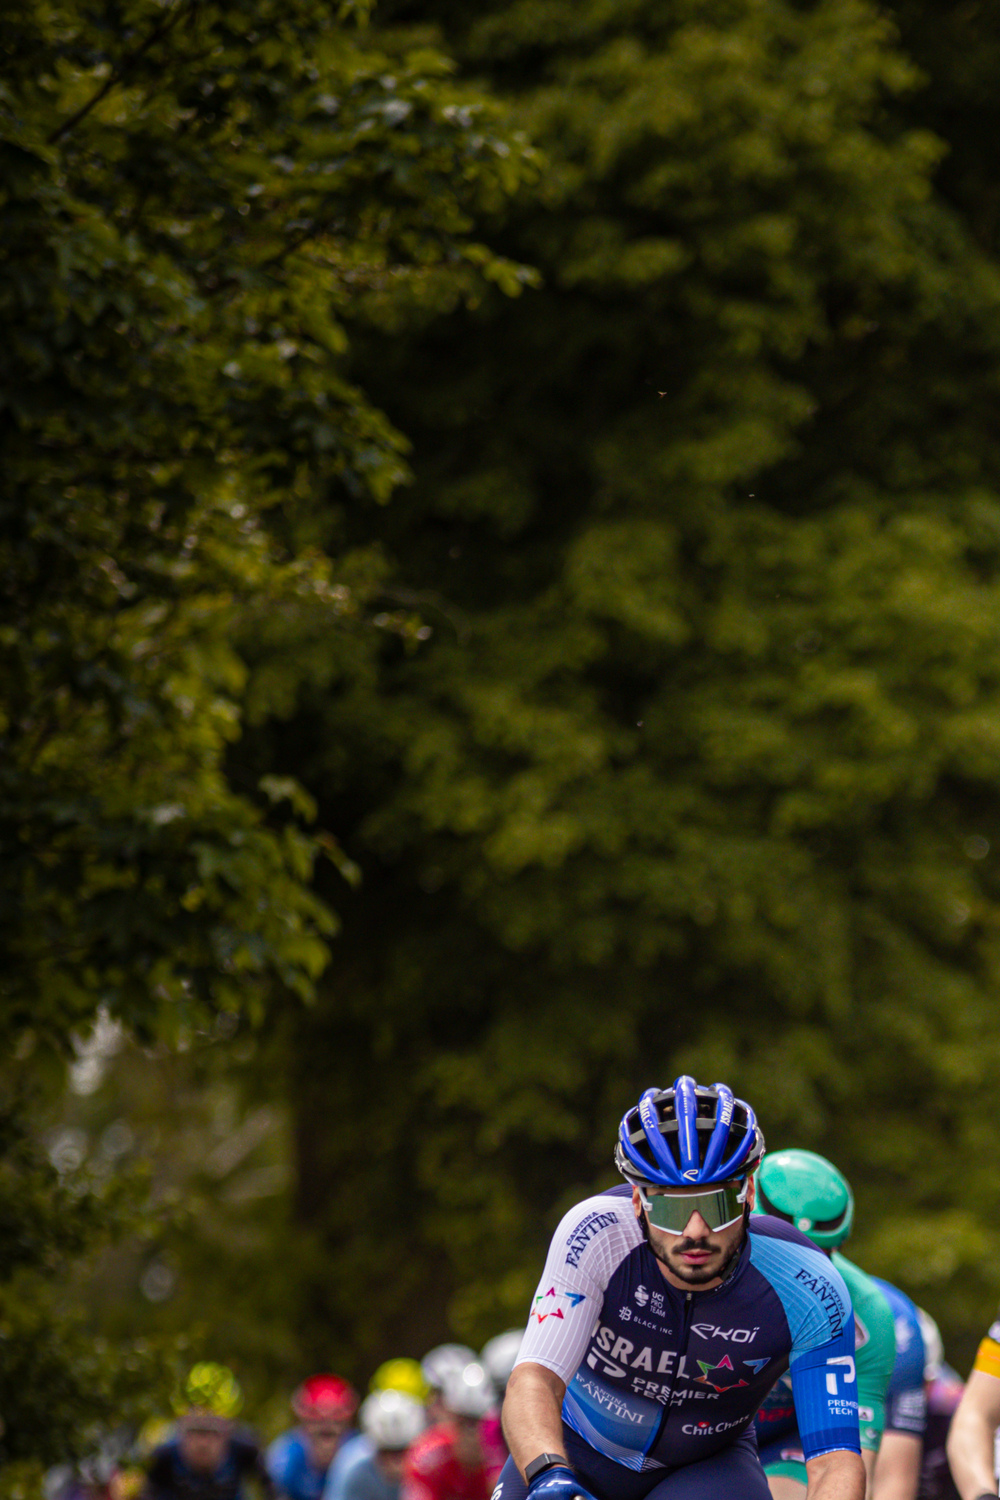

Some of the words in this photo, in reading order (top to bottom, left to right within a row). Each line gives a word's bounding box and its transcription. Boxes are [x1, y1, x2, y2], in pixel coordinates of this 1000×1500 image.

[565, 1211, 619, 1270] FANTINI
[566, 1211, 599, 1246] CANTINA
[650, 1298, 664, 1310] PRO
[652, 1291, 665, 1302] UCI
[793, 1268, 844, 1340] FANTINI
[818, 1275, 846, 1319] CANTINA
[650, 1305, 666, 1318] TEAM
[633, 1315, 658, 1331] BLACK
[660, 1326, 673, 1336] INC
[591, 1317, 690, 1380] ISRAEL
[575, 1372, 646, 1425] FANTINI
[588, 1380, 628, 1409] CANTINA
[630, 1383, 684, 1407] TECH
[632, 1376, 720, 1400] PREMIER
[829, 1407, 853, 1416] TECH
